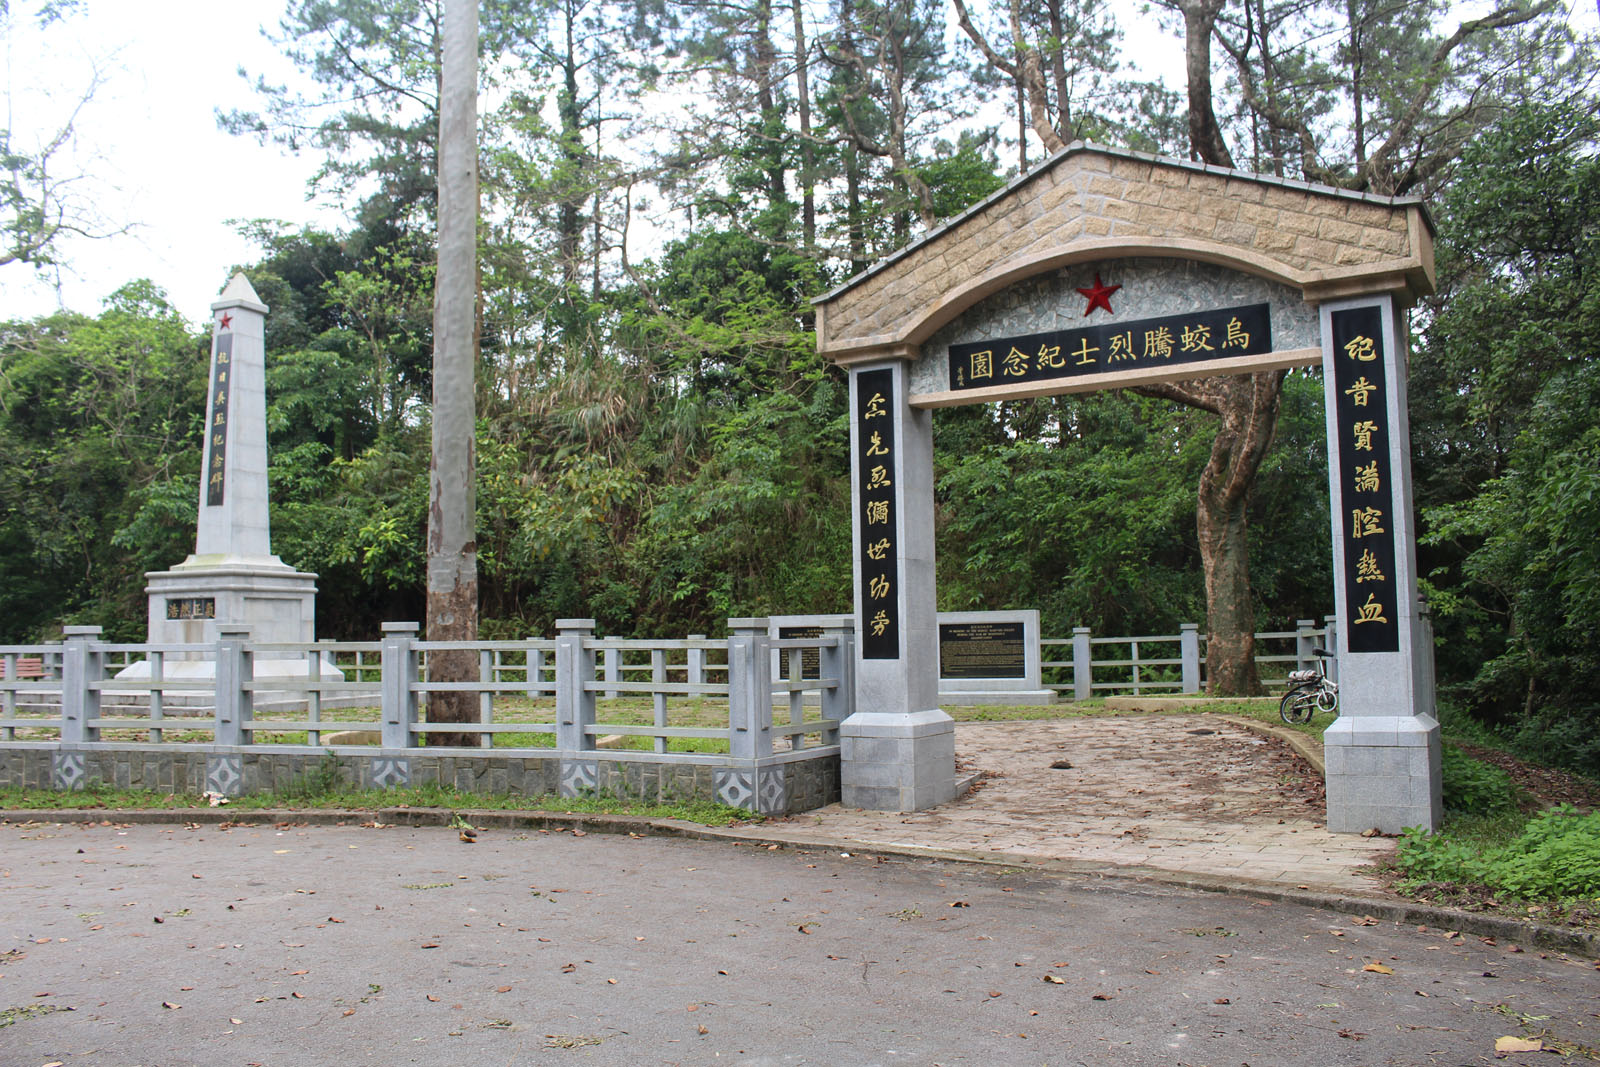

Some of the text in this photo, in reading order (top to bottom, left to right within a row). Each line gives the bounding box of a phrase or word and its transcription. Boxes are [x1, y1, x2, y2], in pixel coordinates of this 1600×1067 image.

[971, 316, 1251, 380] 烏蛟騰烈士紀念園
